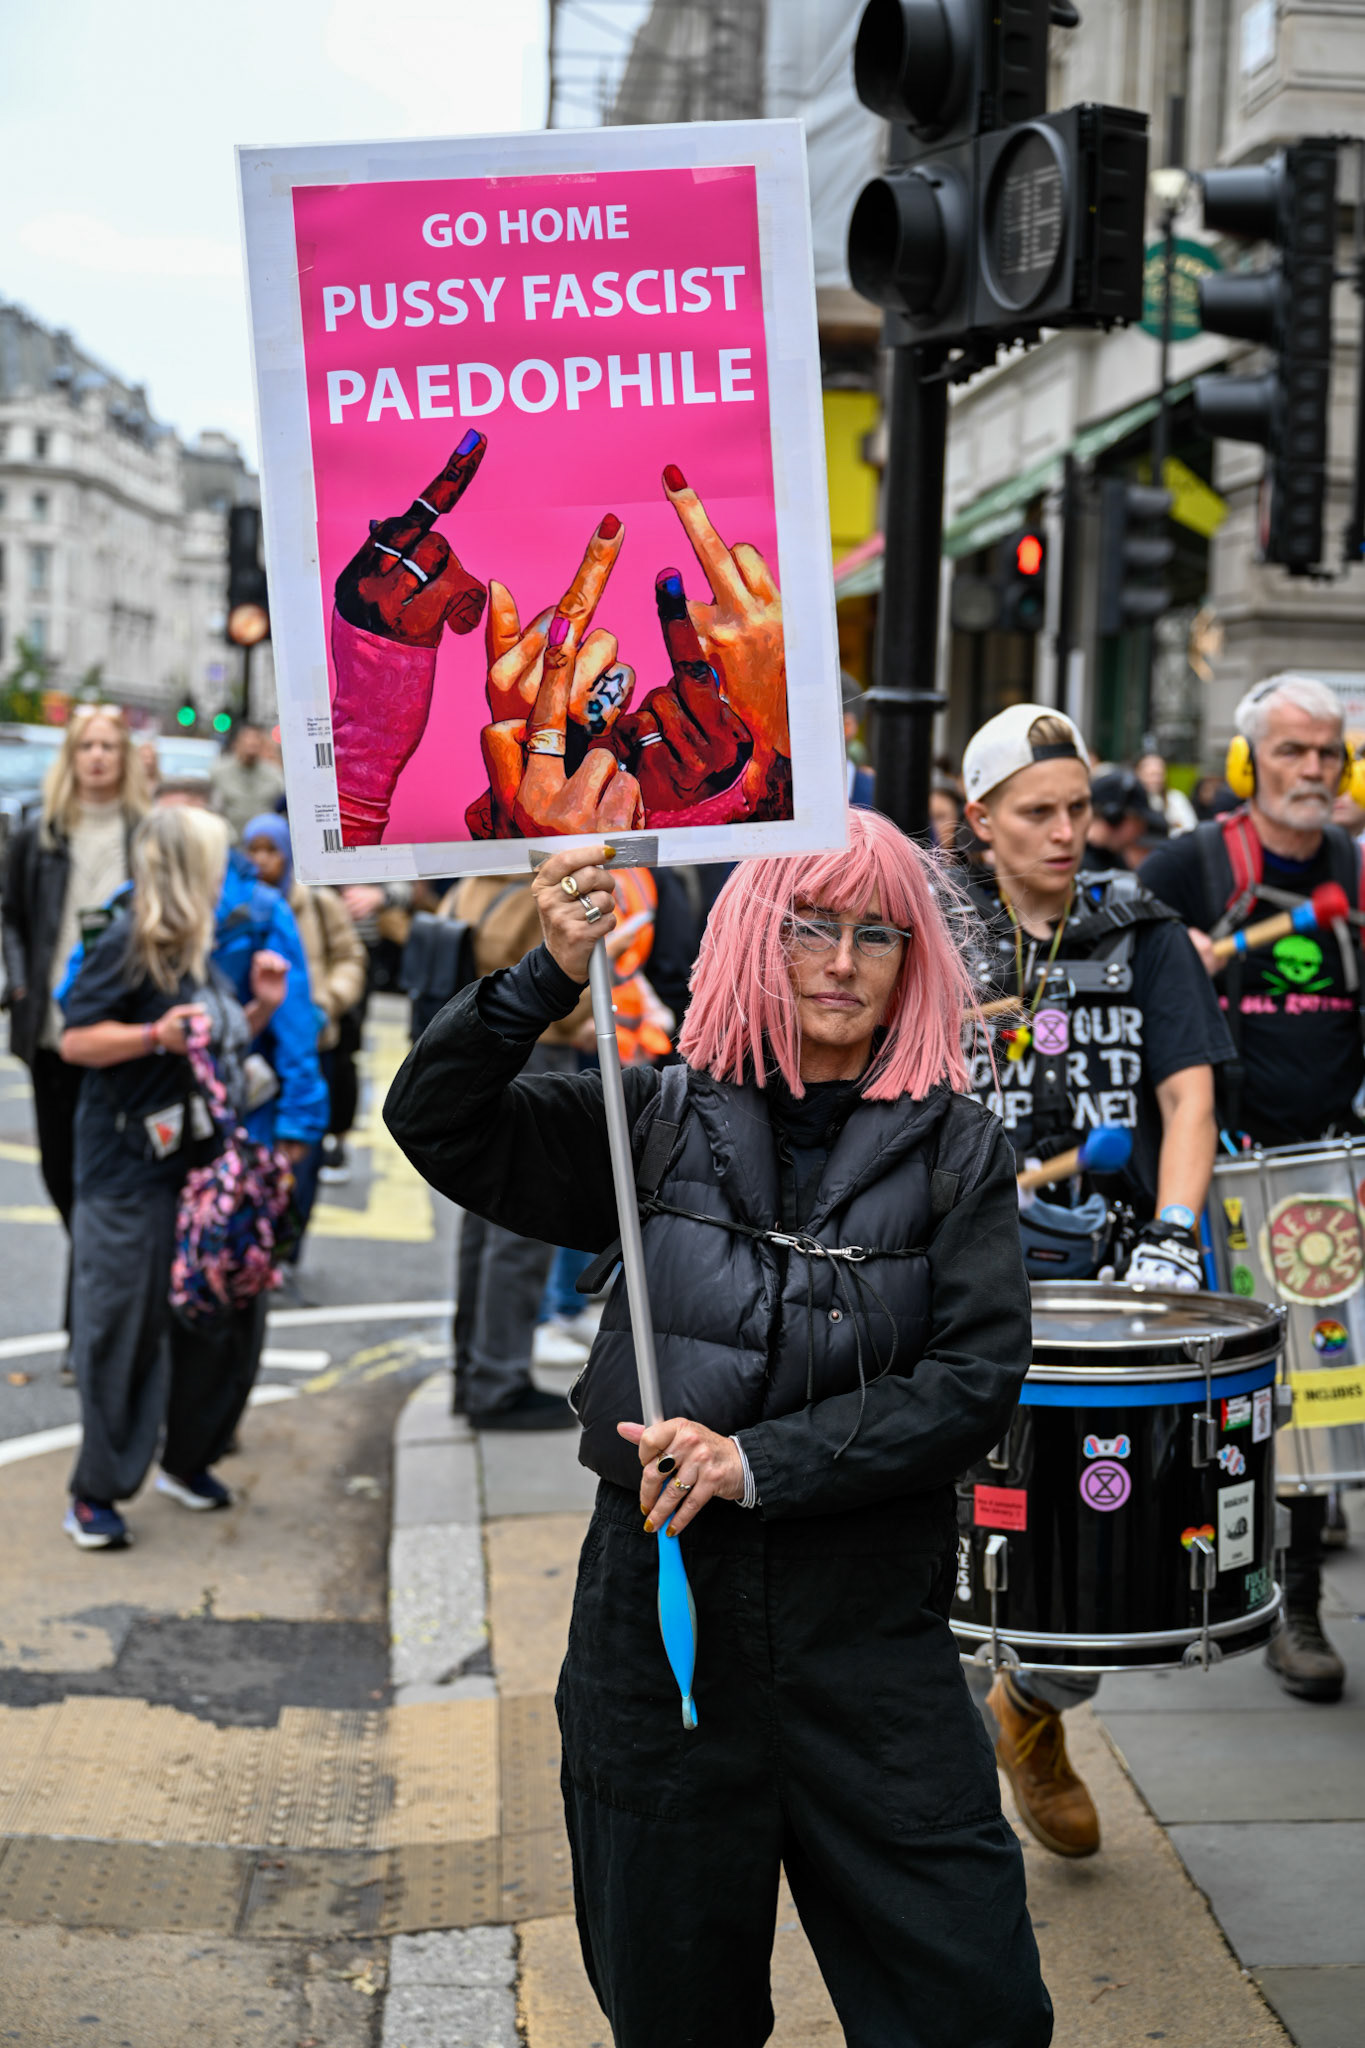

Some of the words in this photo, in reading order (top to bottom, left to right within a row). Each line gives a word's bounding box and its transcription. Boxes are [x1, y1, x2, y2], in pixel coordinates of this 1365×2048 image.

[423, 212, 486, 247] GO
[500, 205, 629, 244] HOME
[323, 277, 505, 331] PUSSY
[523, 266, 745, 320] FASCIST
[327, 348, 754, 424] PAEDOPHILE
[1066, 1006, 1144, 1046] OUR
[1325, 1209, 1364, 1280] LESS
